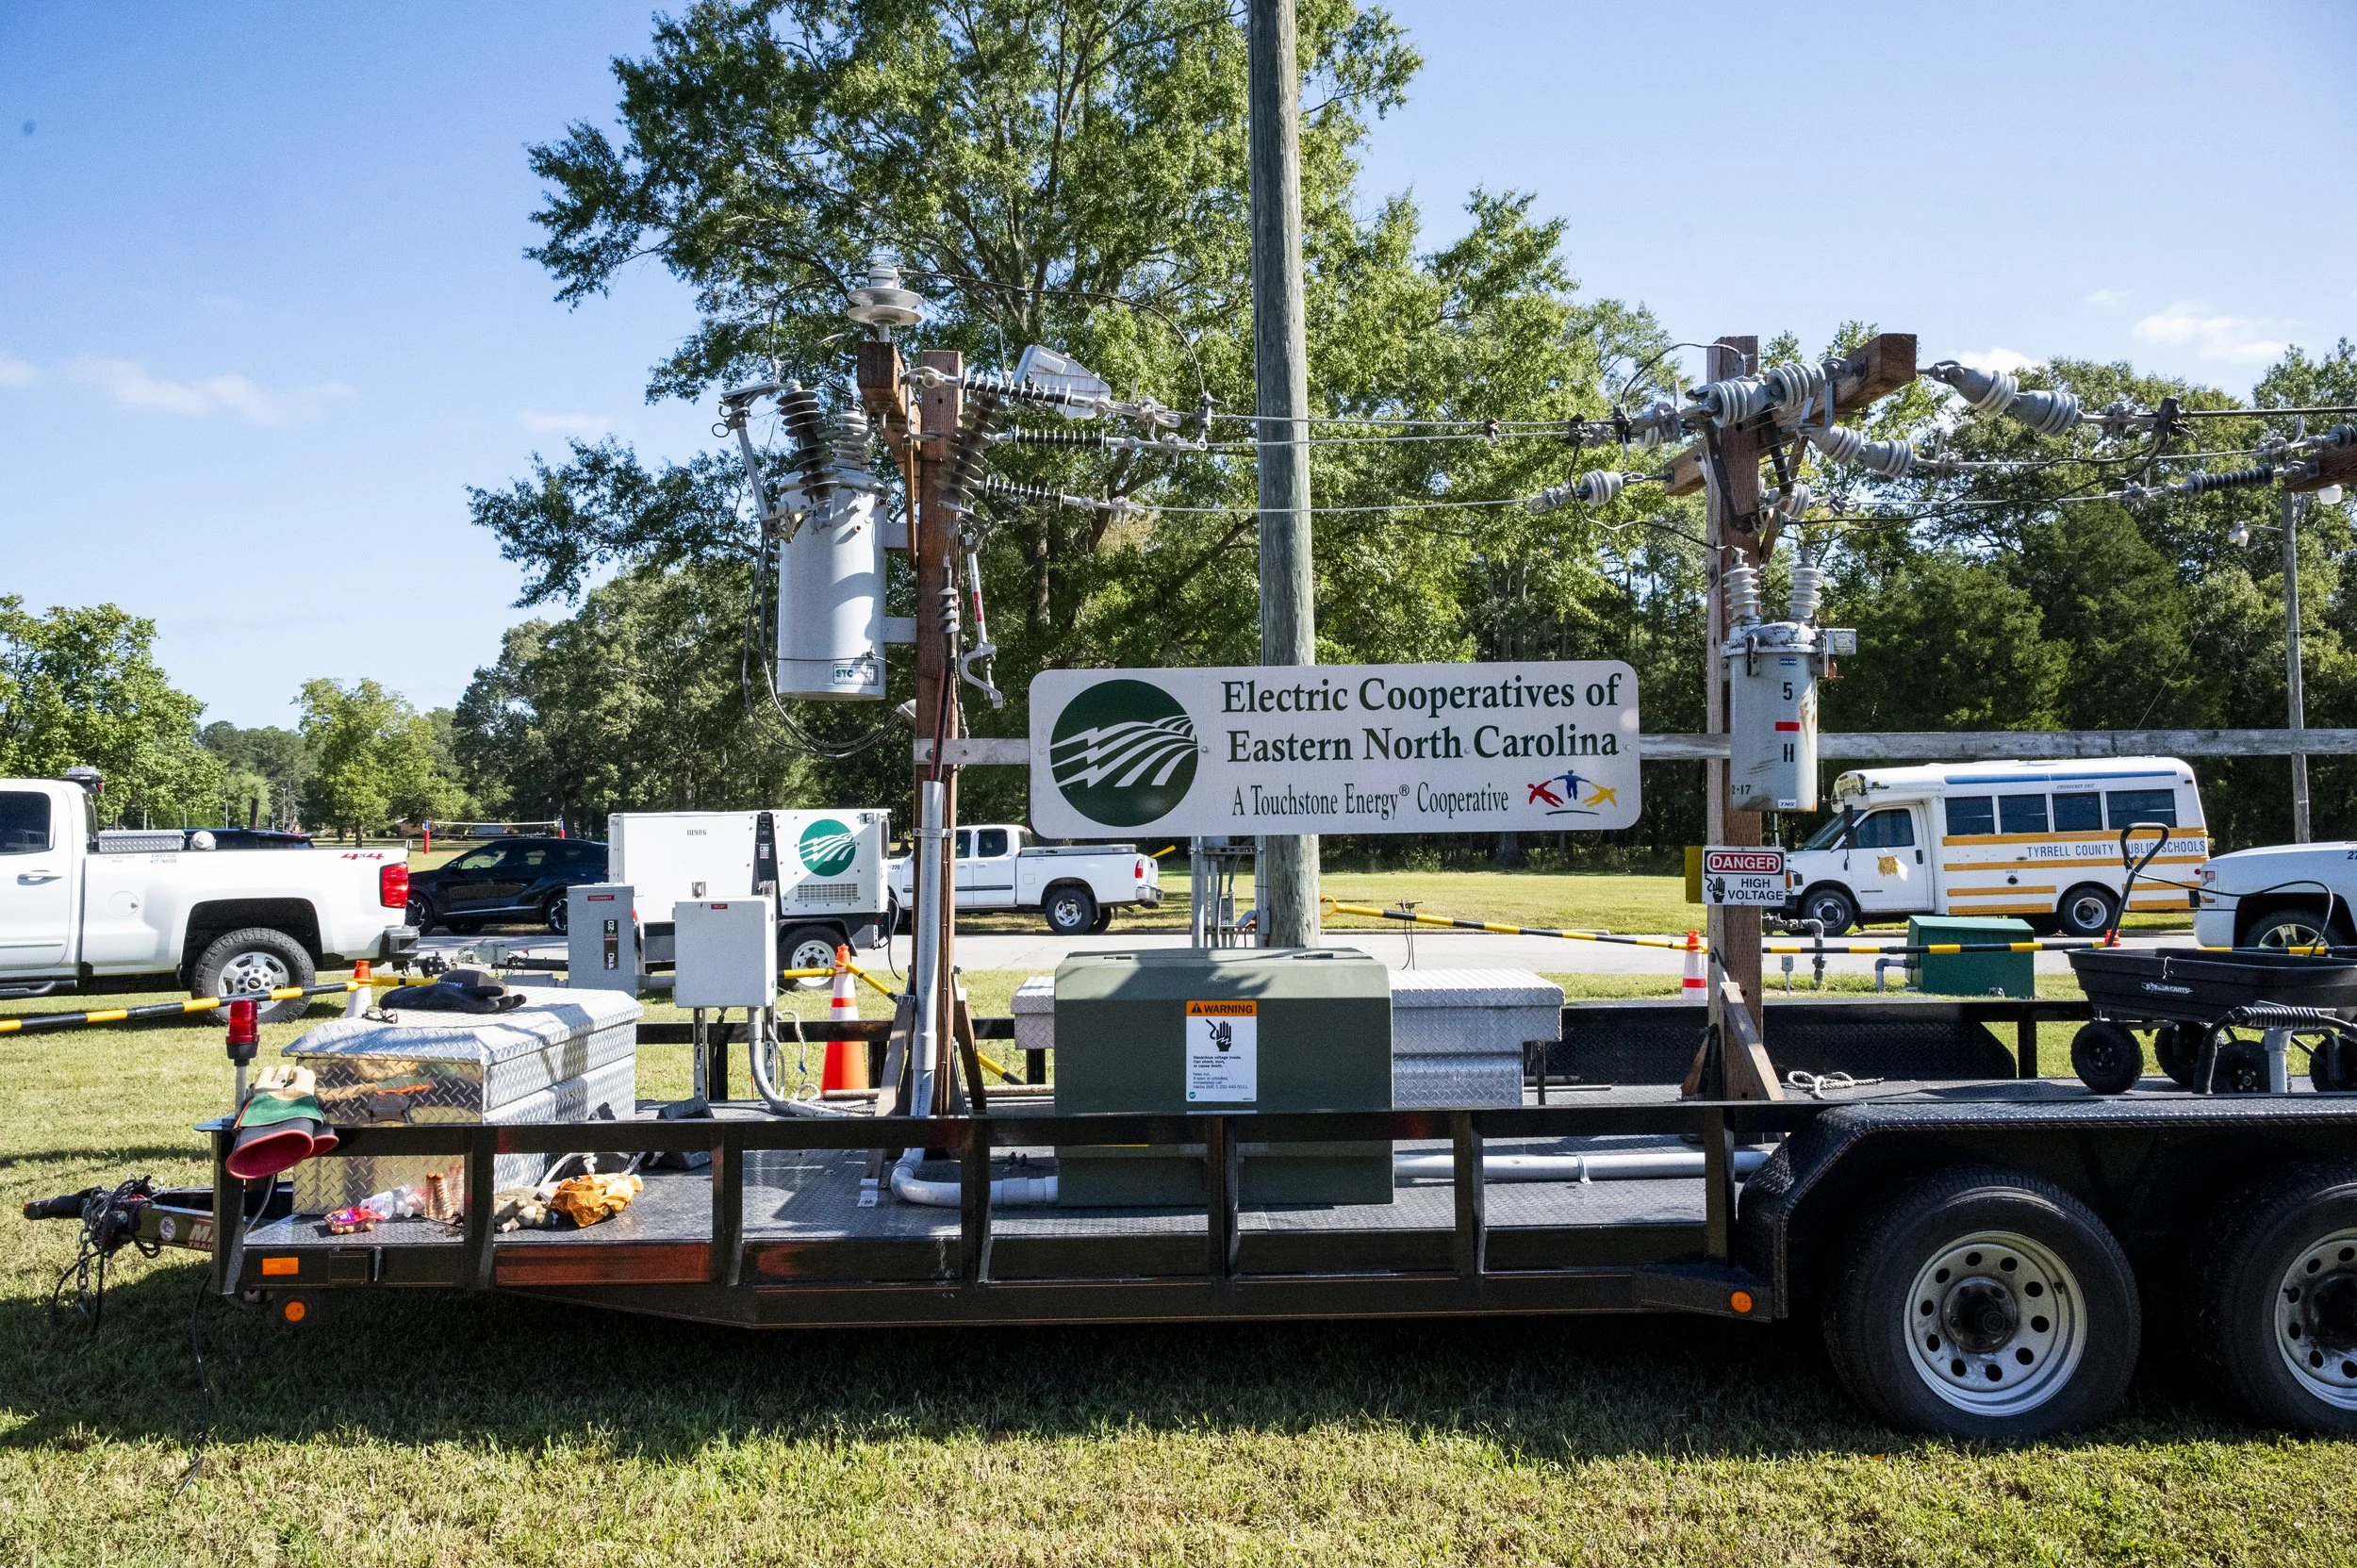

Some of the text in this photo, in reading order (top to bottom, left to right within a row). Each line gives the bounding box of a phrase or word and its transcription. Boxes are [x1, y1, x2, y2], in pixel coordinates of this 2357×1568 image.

[1221, 672, 1622, 718] Electric Cooperatives of
[1783, 682, 1793, 701] 5
[1227, 723, 1620, 762] Eastern North Carolina
[1232, 785, 1244, 816] A
[1250, 784, 1338, 816] Touchstone
[1418, 782, 1508, 818] Cooperative
[2027, 840, 2205, 858] TYRRELL COUNTY UBLIC SCHOOLS
[1711, 855, 1777, 869] DANGER
[1740, 878, 1771, 888] HIGH
[1727, 889, 1784, 900] VOLTAGE
[1204, 1004, 1253, 1014] WARNING
